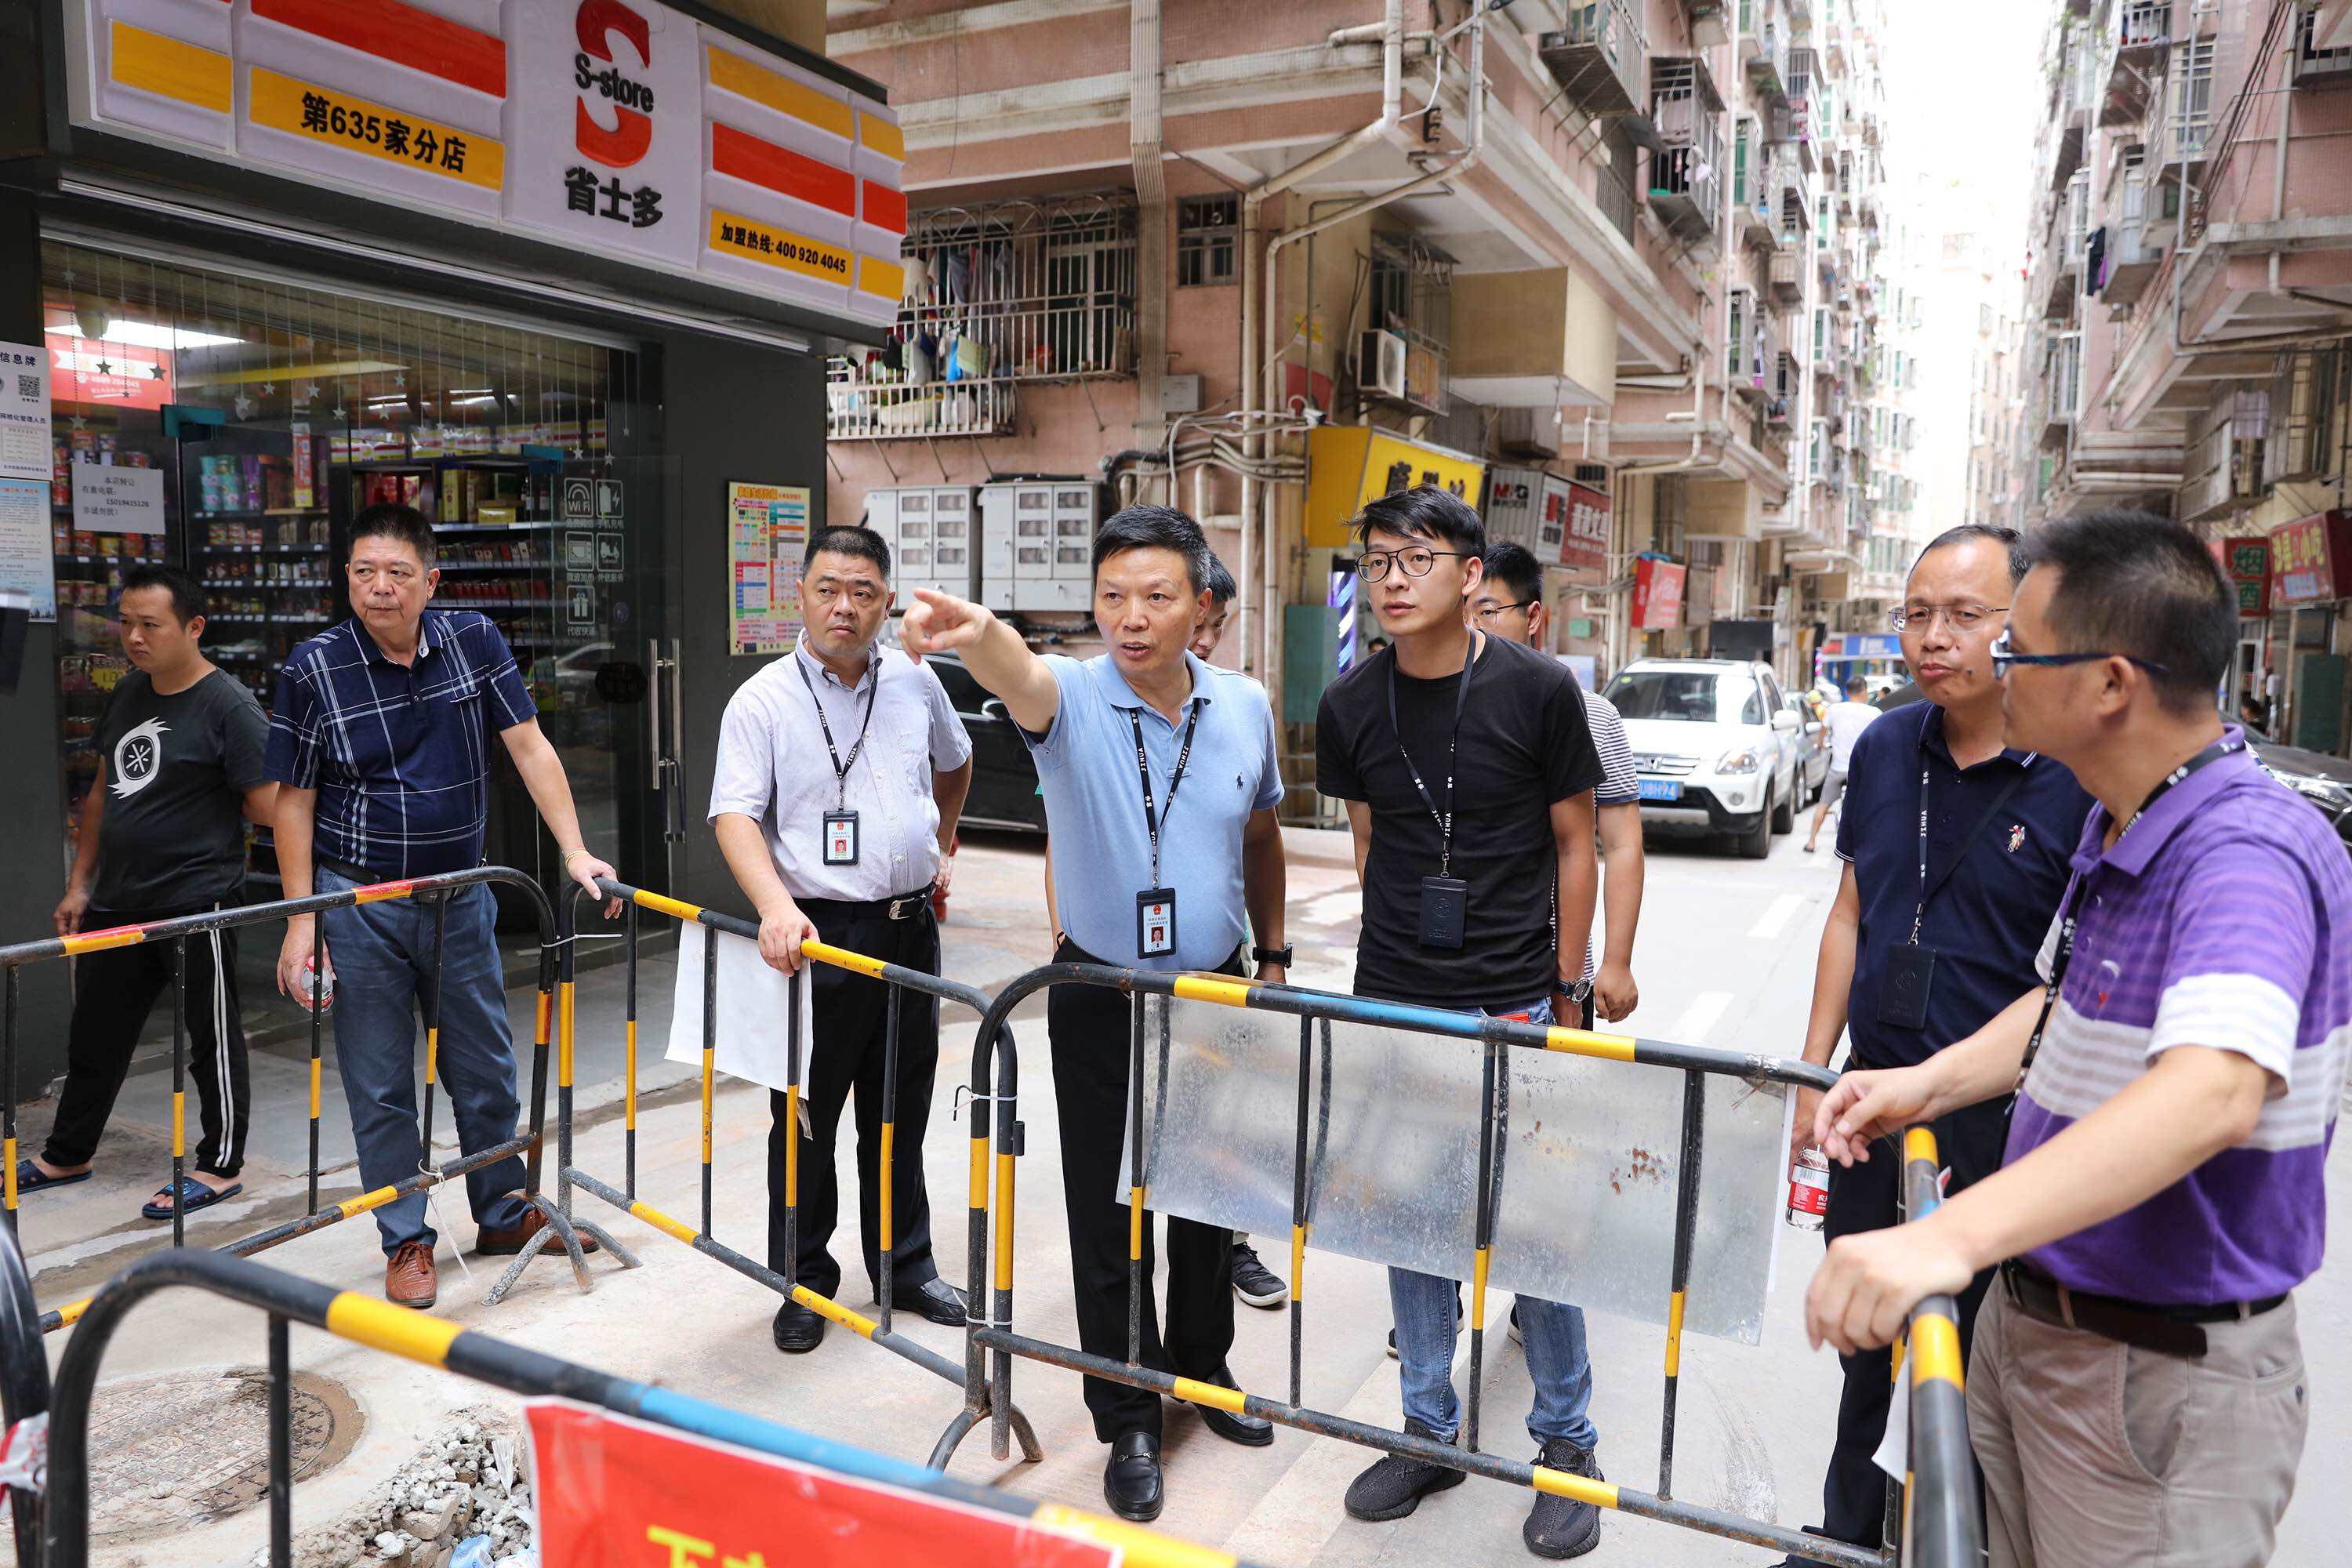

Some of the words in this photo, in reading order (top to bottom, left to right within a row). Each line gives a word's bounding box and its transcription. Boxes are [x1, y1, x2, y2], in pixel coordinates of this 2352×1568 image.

[575, 53, 655, 114] S-store
[300, 91, 466, 173] 第635家分店
[564, 167, 663, 227] 省士多
[720, 222, 775, 255] 加盟热线:
[776, 241, 797, 260] 400
[799, 249, 818, 265] 920
[821, 254, 847, 273] 4045
